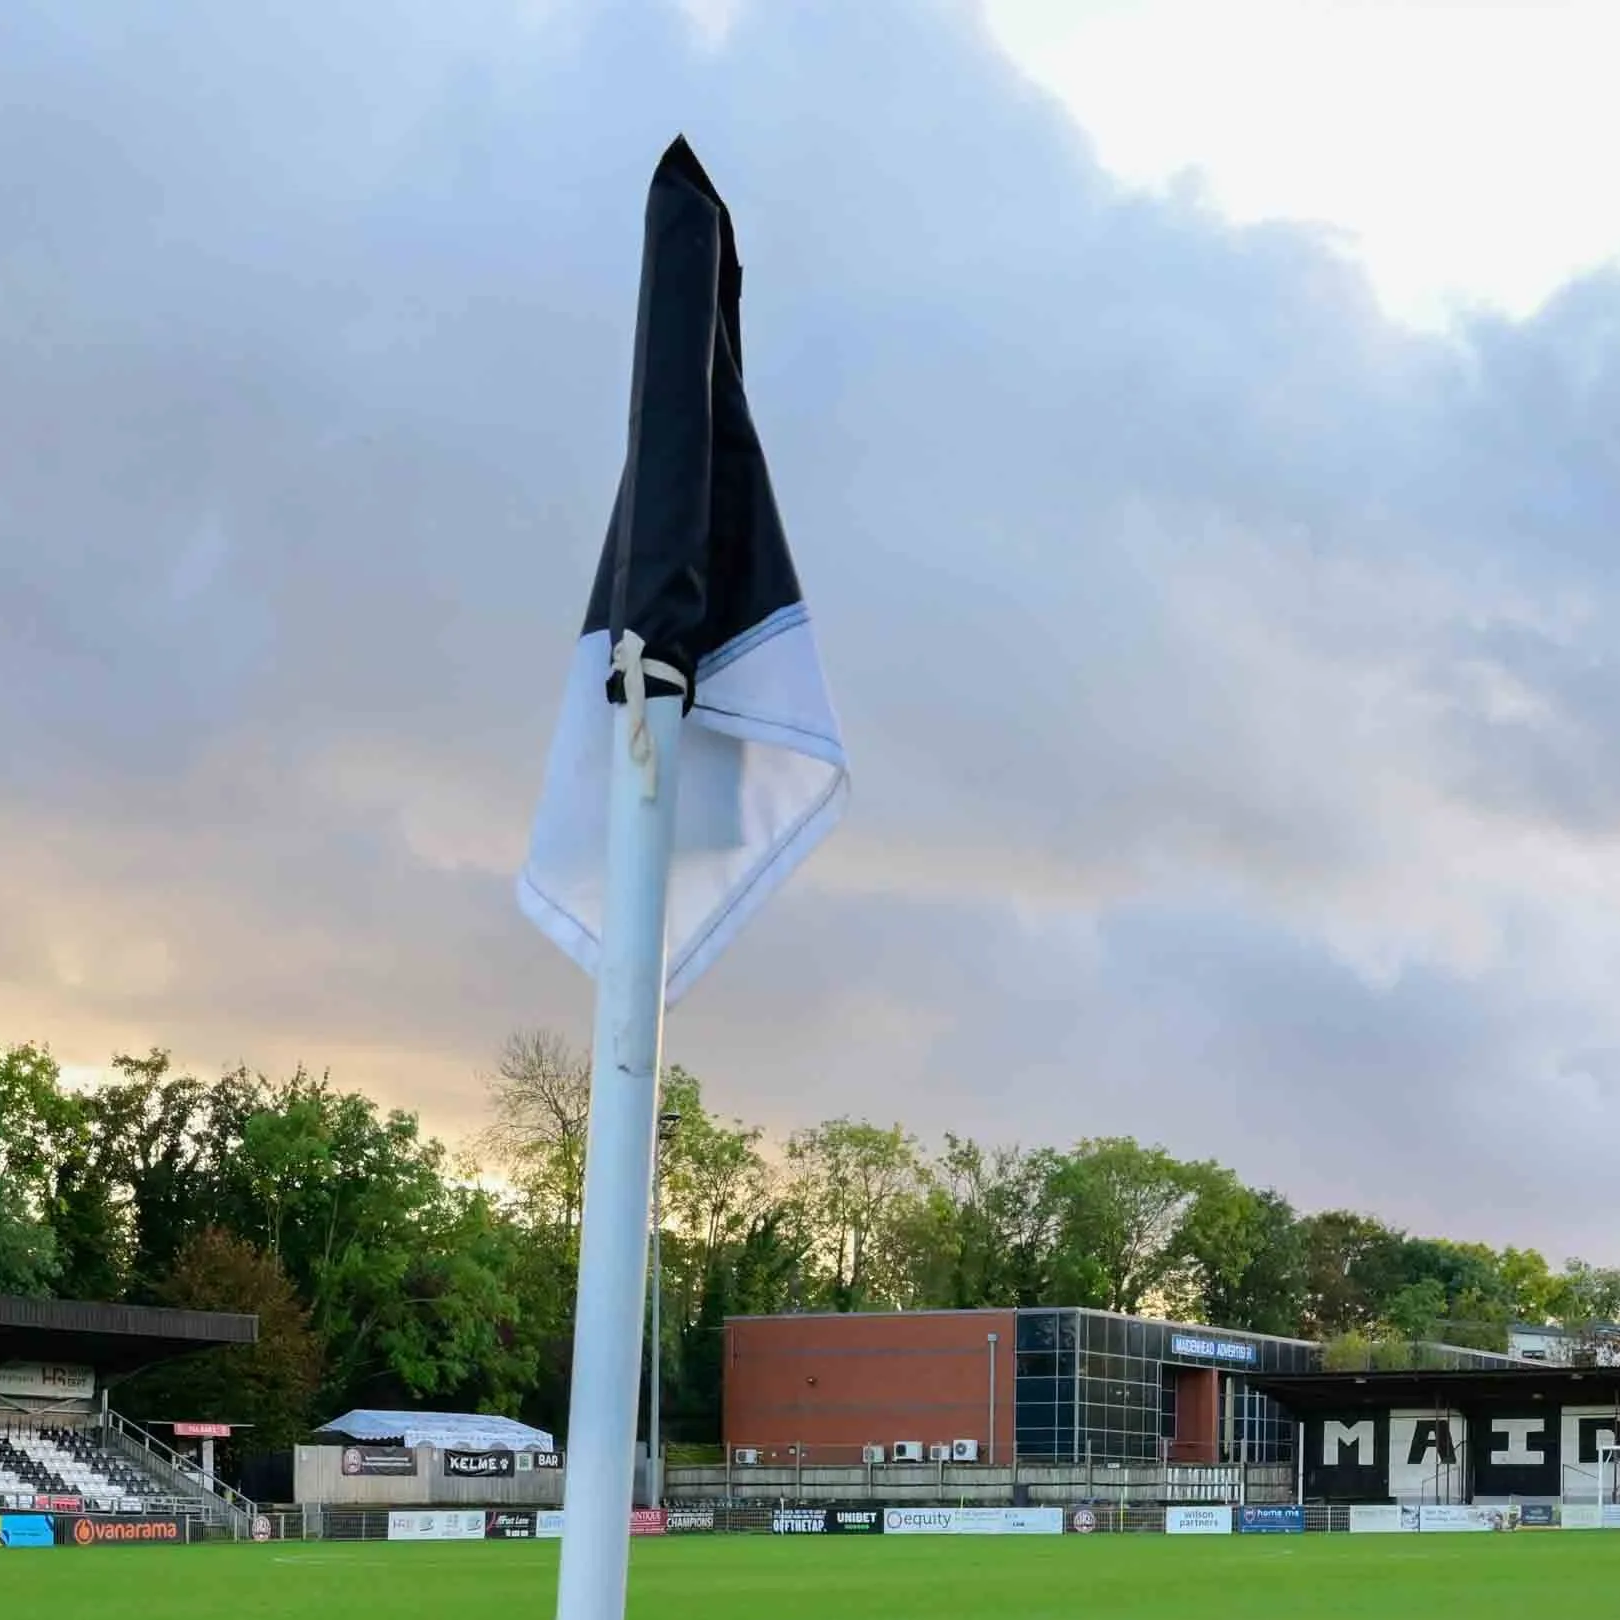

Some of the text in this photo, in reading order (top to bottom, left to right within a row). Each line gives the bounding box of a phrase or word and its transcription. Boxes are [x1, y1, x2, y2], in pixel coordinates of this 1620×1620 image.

[450, 1456, 497, 1470] KELME
[538, 1454, 558, 1467] BAR
[837, 1512, 877, 1523] UNIBET
[904, 1511, 951, 1529] equity
[1184, 1510, 1214, 1518] wilson
[1179, 1518, 1218, 1528] partners
[95, 1521, 178, 1540] vanarama
